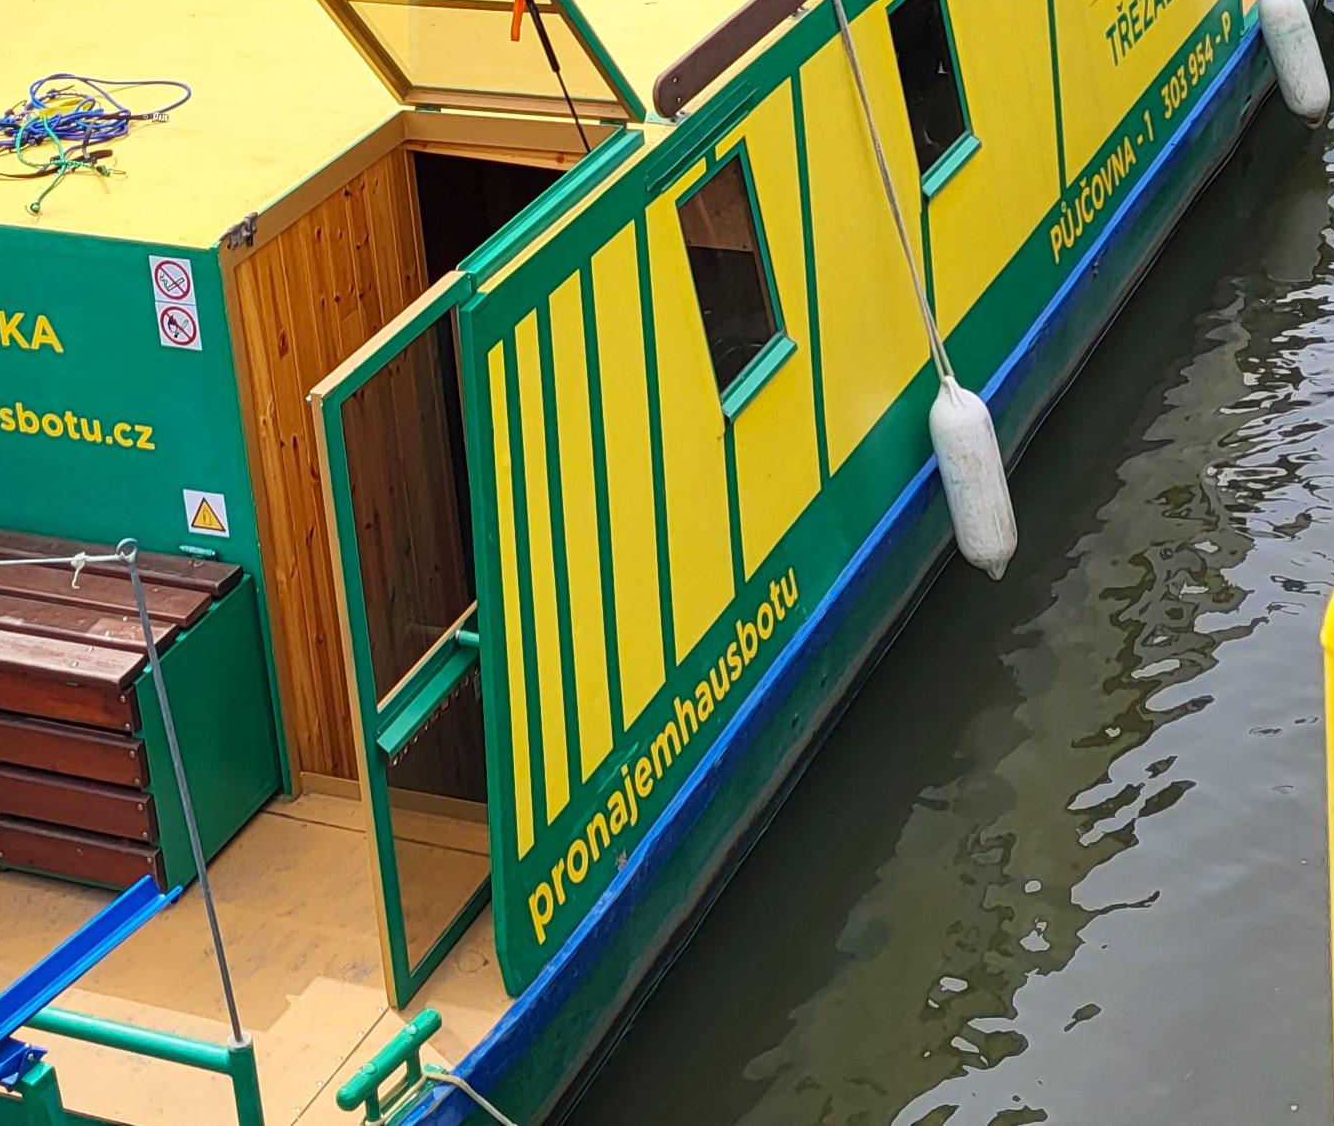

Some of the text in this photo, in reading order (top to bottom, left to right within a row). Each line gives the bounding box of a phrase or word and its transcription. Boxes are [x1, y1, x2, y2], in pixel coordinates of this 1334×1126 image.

[1049, 136, 1137, 265] PŮJČOVNA
[1160, 64, 1188, 120] 303
[1188, 32, 1214, 87] 954
[1221, 10, 1232, 44] P
[526, 566, 800, 947] pronajemhausbotu
